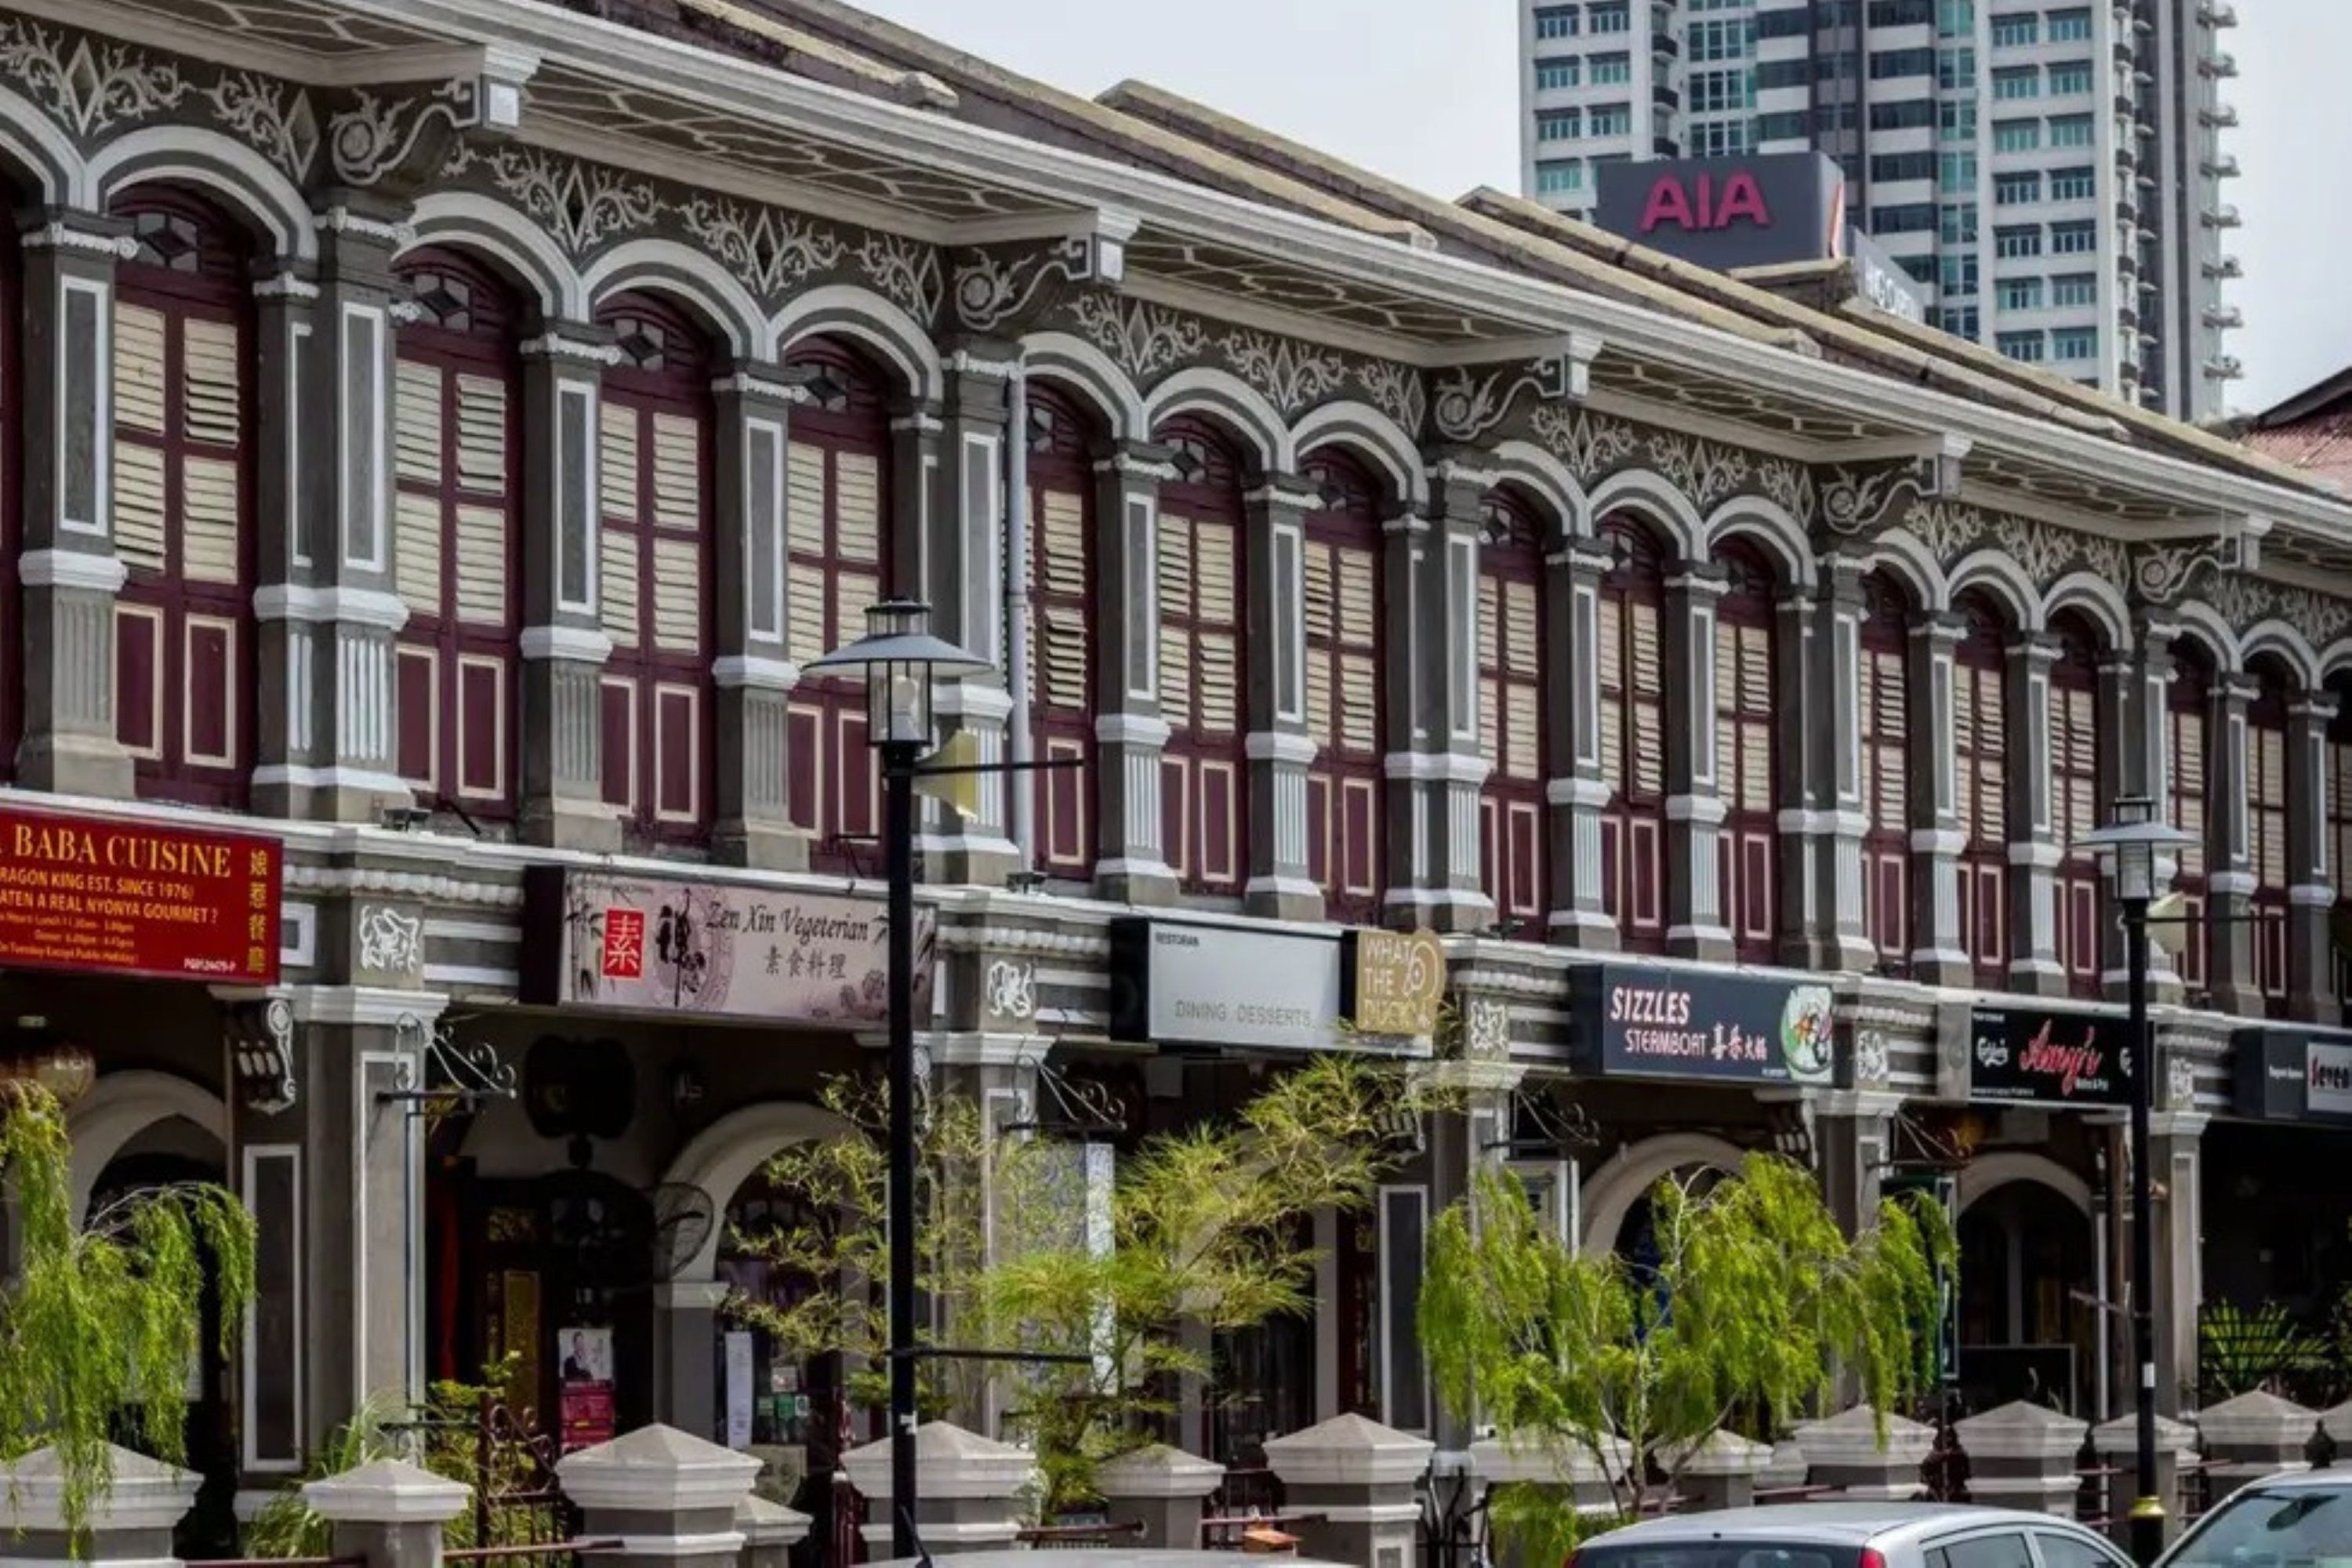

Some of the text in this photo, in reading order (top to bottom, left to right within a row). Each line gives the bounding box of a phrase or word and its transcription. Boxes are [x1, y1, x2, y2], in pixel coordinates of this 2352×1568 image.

[1639, 170, 1771, 233] AIA
[15, 823, 231, 878] BABA CUISINE
[52, 872, 85, 890] KING
[87, 874, 114, 892] EST.
[117, 877, 154, 897] SINCE
[49, 893, 82, 913] REAL
[86, 897, 140, 916] NYONYA
[143, 902, 209, 924] GOURMET
[706, 901, 740, 929] Zen
[742, 904, 775, 933] Xin
[606, 914, 640, 971] 素
[1364, 938, 1410, 961] WHAT
[764, 944, 847, 978] 素食料理
[1364, 967, 1394, 996] THE
[1174, 999, 1312, 1027] DINING DESSERTS
[1610, 986, 1691, 1025] SIZZLES
[1624, 1028, 1708, 1058] STEAMBOAT
